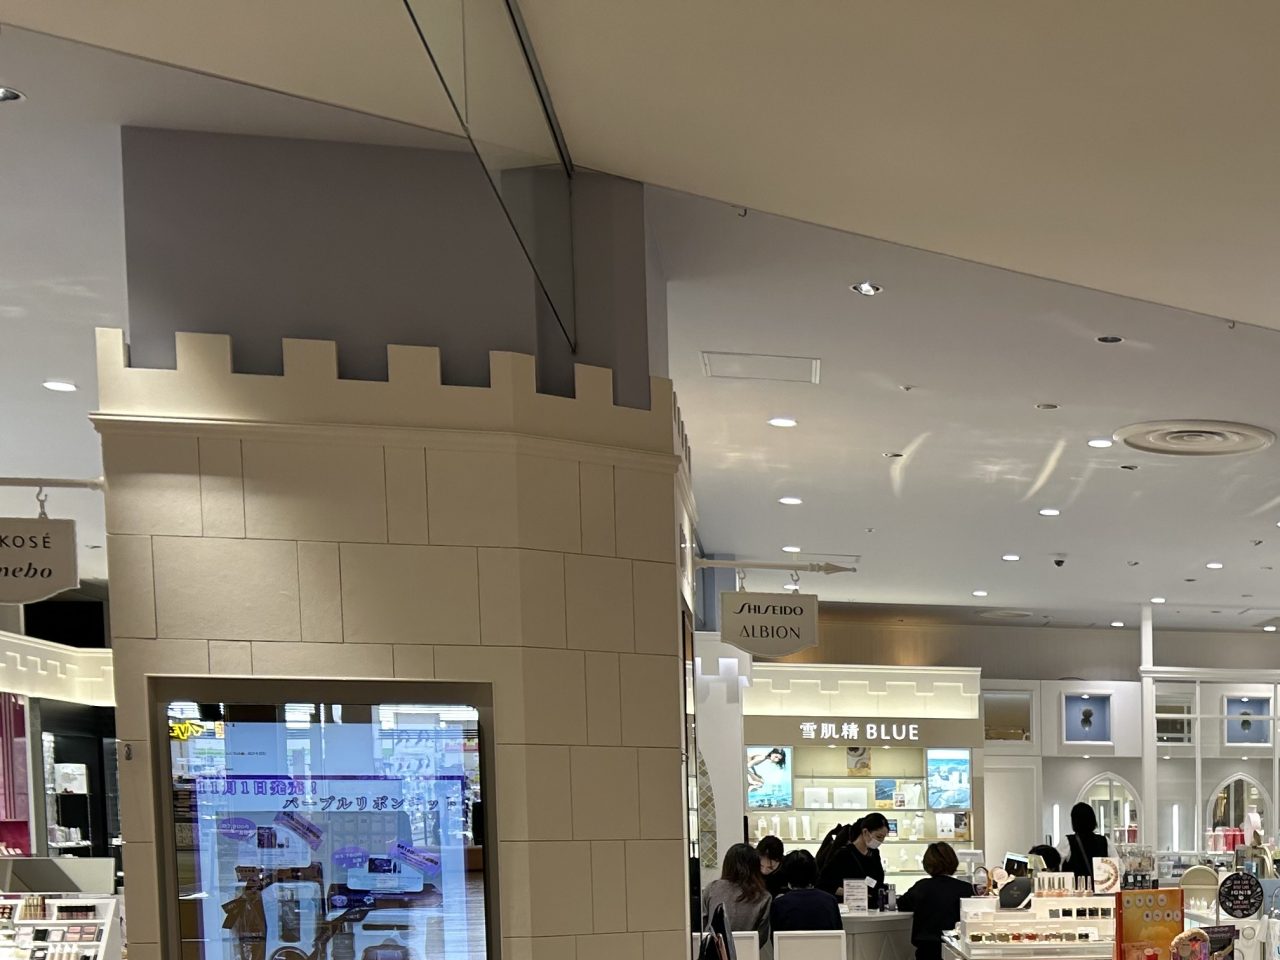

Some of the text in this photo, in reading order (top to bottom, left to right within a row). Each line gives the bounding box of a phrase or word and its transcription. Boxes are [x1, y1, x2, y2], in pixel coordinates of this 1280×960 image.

[0, 532, 52, 549] KOSÉ
[733, 602, 804, 616] SHISEIDO
[739, 625, 801, 640] ALBION
[800, 722, 919, 741] 雪肌精 BLUE
